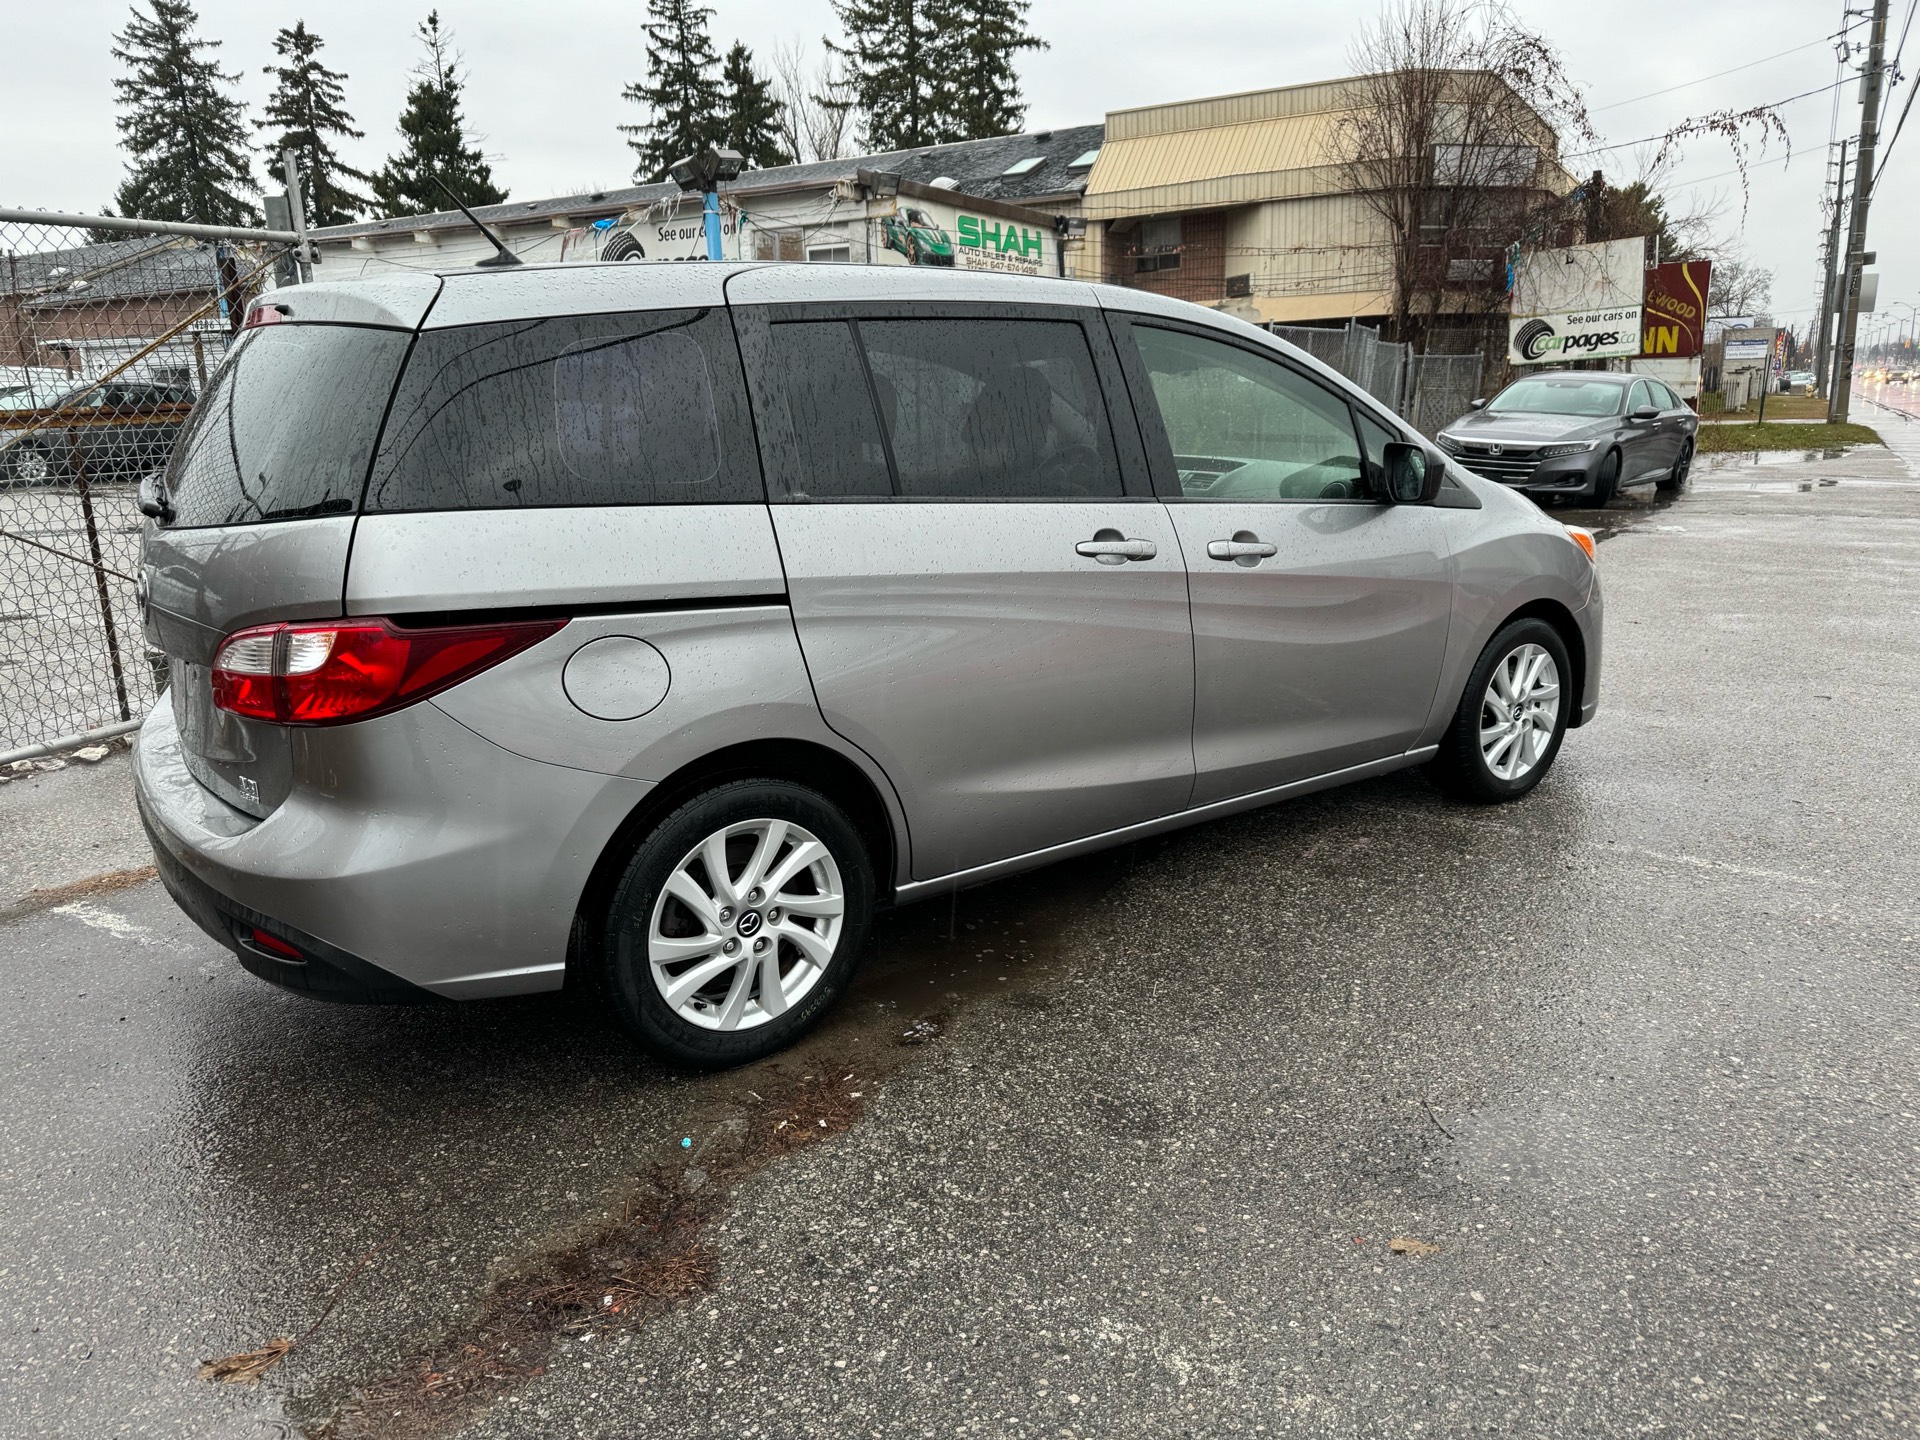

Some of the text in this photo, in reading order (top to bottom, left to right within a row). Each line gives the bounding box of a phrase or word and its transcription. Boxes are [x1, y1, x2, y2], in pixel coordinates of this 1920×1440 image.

[657, 227, 677, 242] See
[679, 227, 697, 239] our
[958, 215, 1042, 259] SHAH
[959, 247, 980, 257] AUTO
[982, 251, 1006, 261] SALES
[1015, 256, 1043, 267] REPAIRS
[966, 256, 988, 268] SHAH:
[1566, 311, 1637, 325] See our cars on
